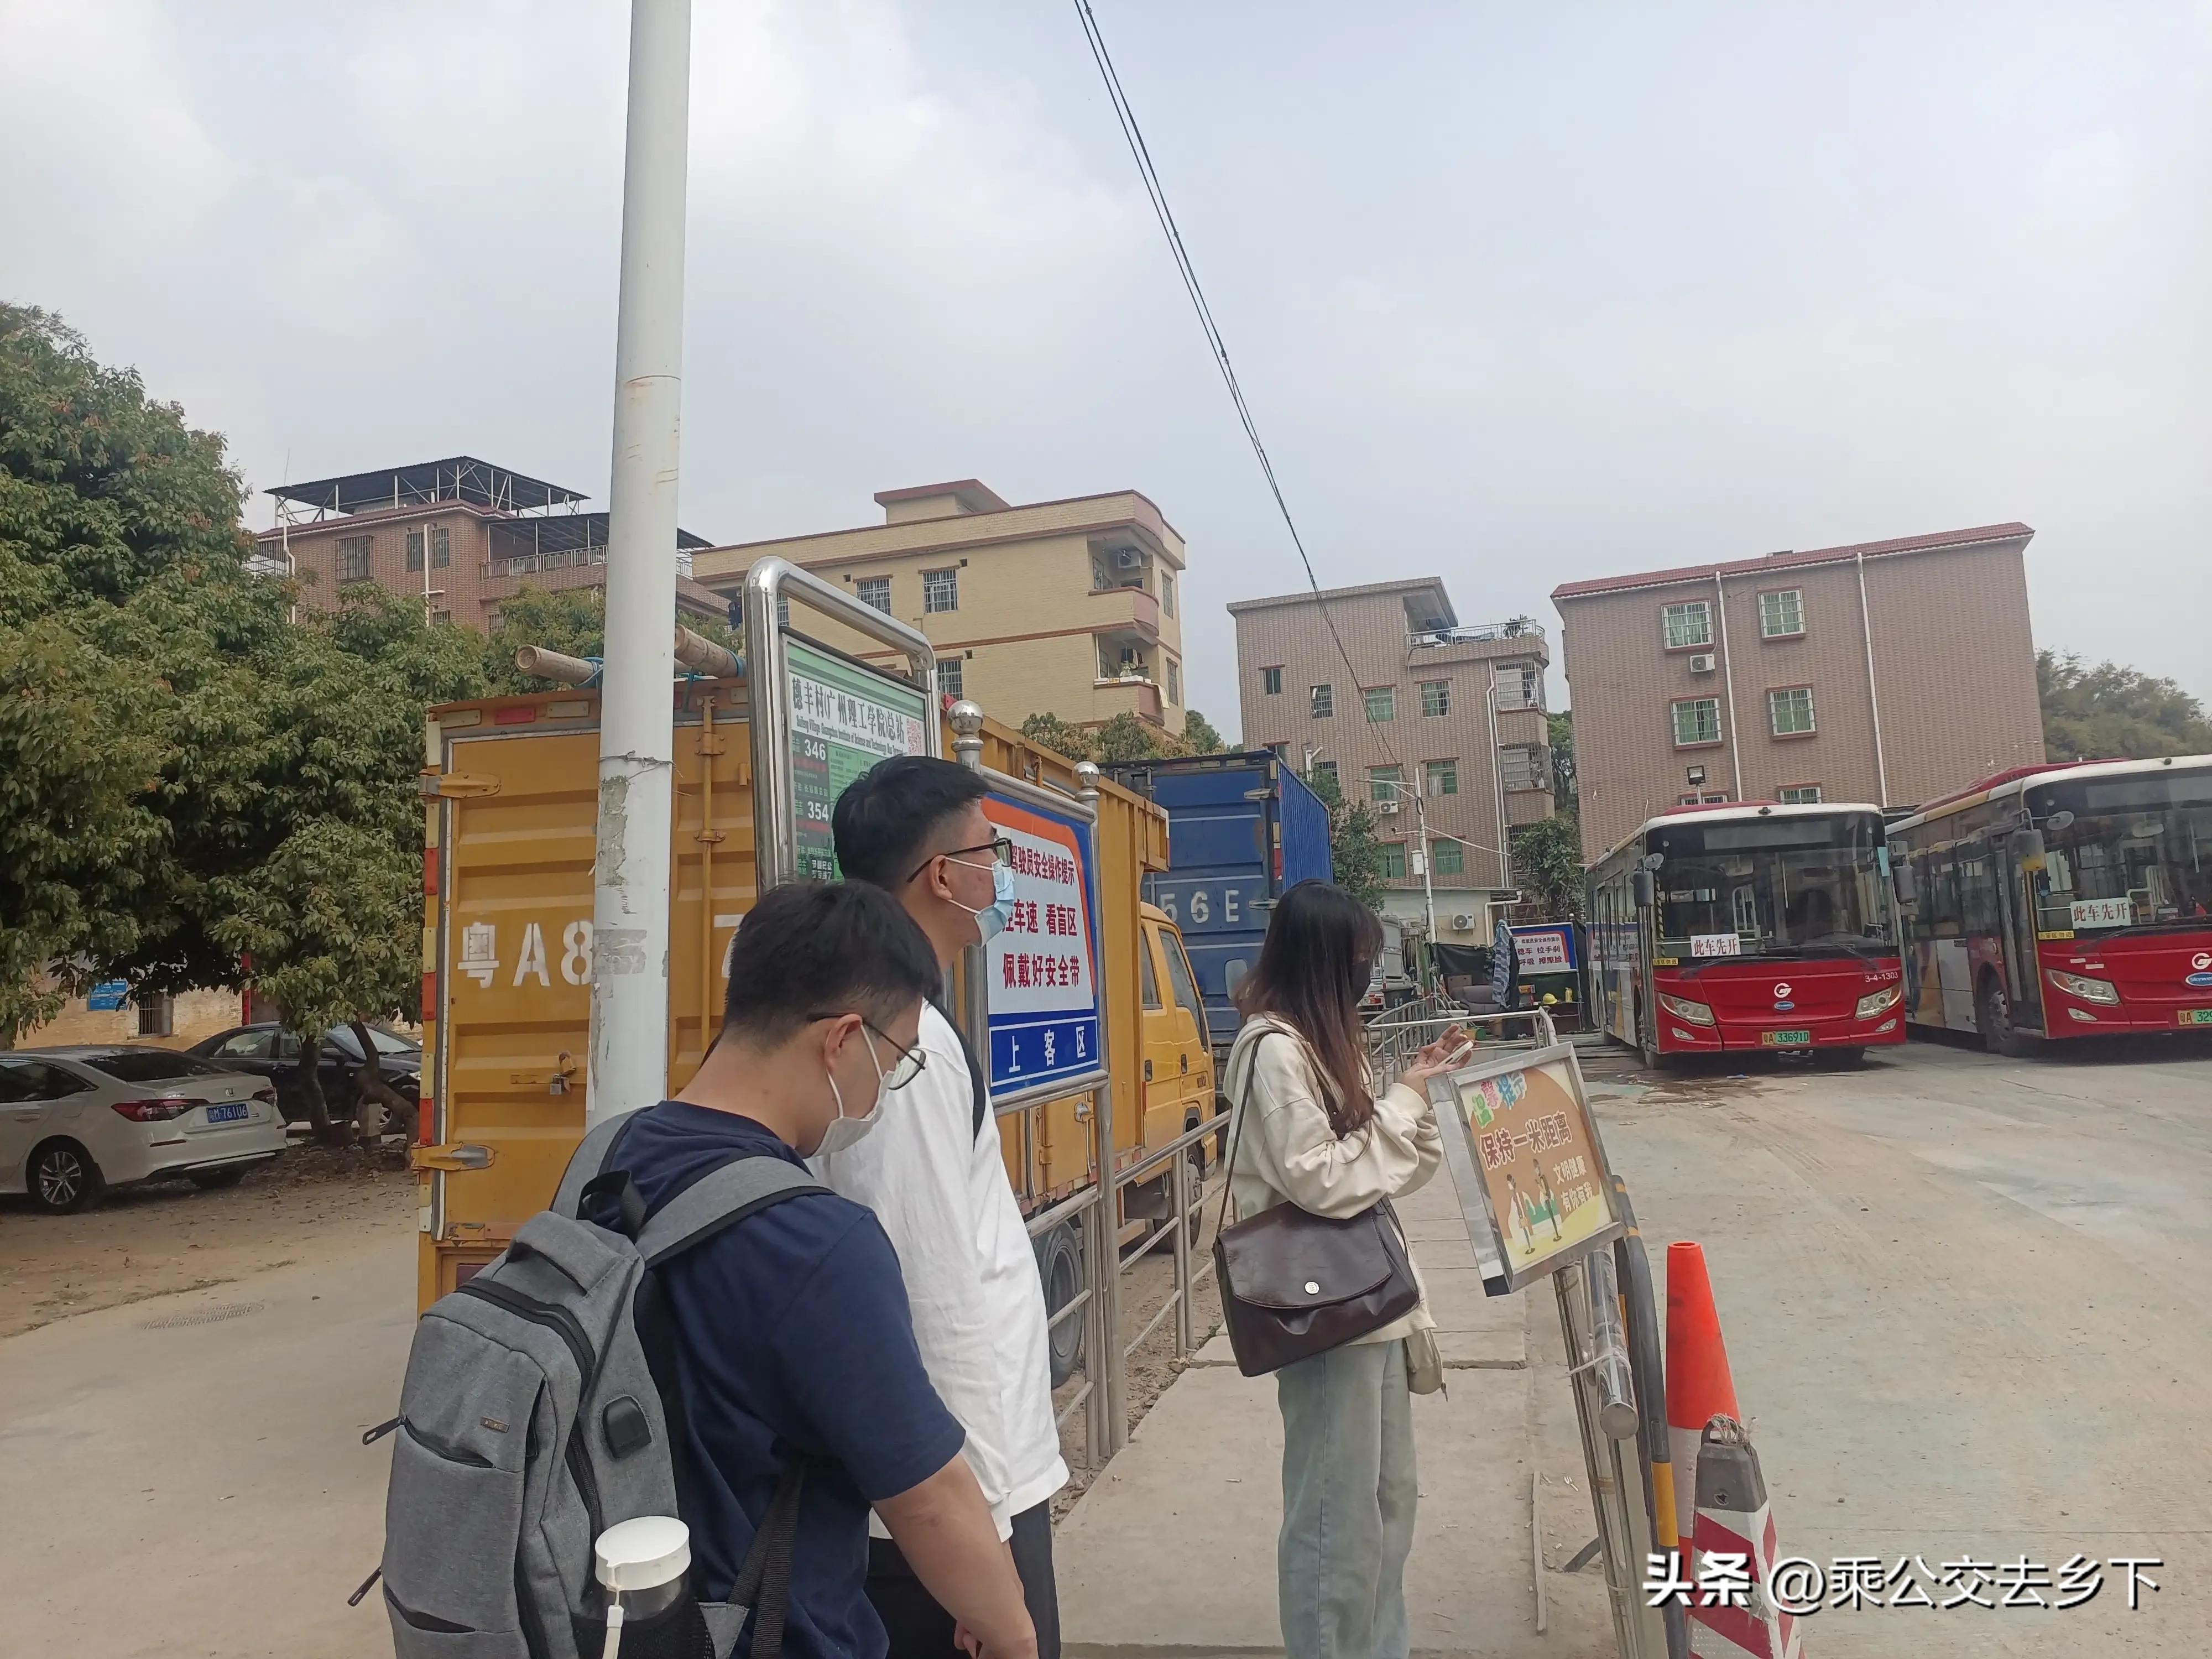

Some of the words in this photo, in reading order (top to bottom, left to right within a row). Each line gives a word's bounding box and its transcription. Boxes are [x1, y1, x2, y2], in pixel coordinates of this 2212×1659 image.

[804, 739, 826, 760] 346
[807, 801, 829, 822] 354
[1046, 903, 1077, 936] 看盲区
[2073, 902, 2128, 922] 此车先开
[1694, 938, 1738, 956] 此车先开
[1003, 953, 1080, 989] 佩戴好安全带
[1864, 971, 1898, 983] 3-4-1303
[1009, 1025, 1086, 1073] 上客区
[1480, 1111, 1572, 1171] 保持一米距离
[1553, 1155, 1587, 1185] 文明健康
[1561, 1181, 1593, 1213] 有你有我
